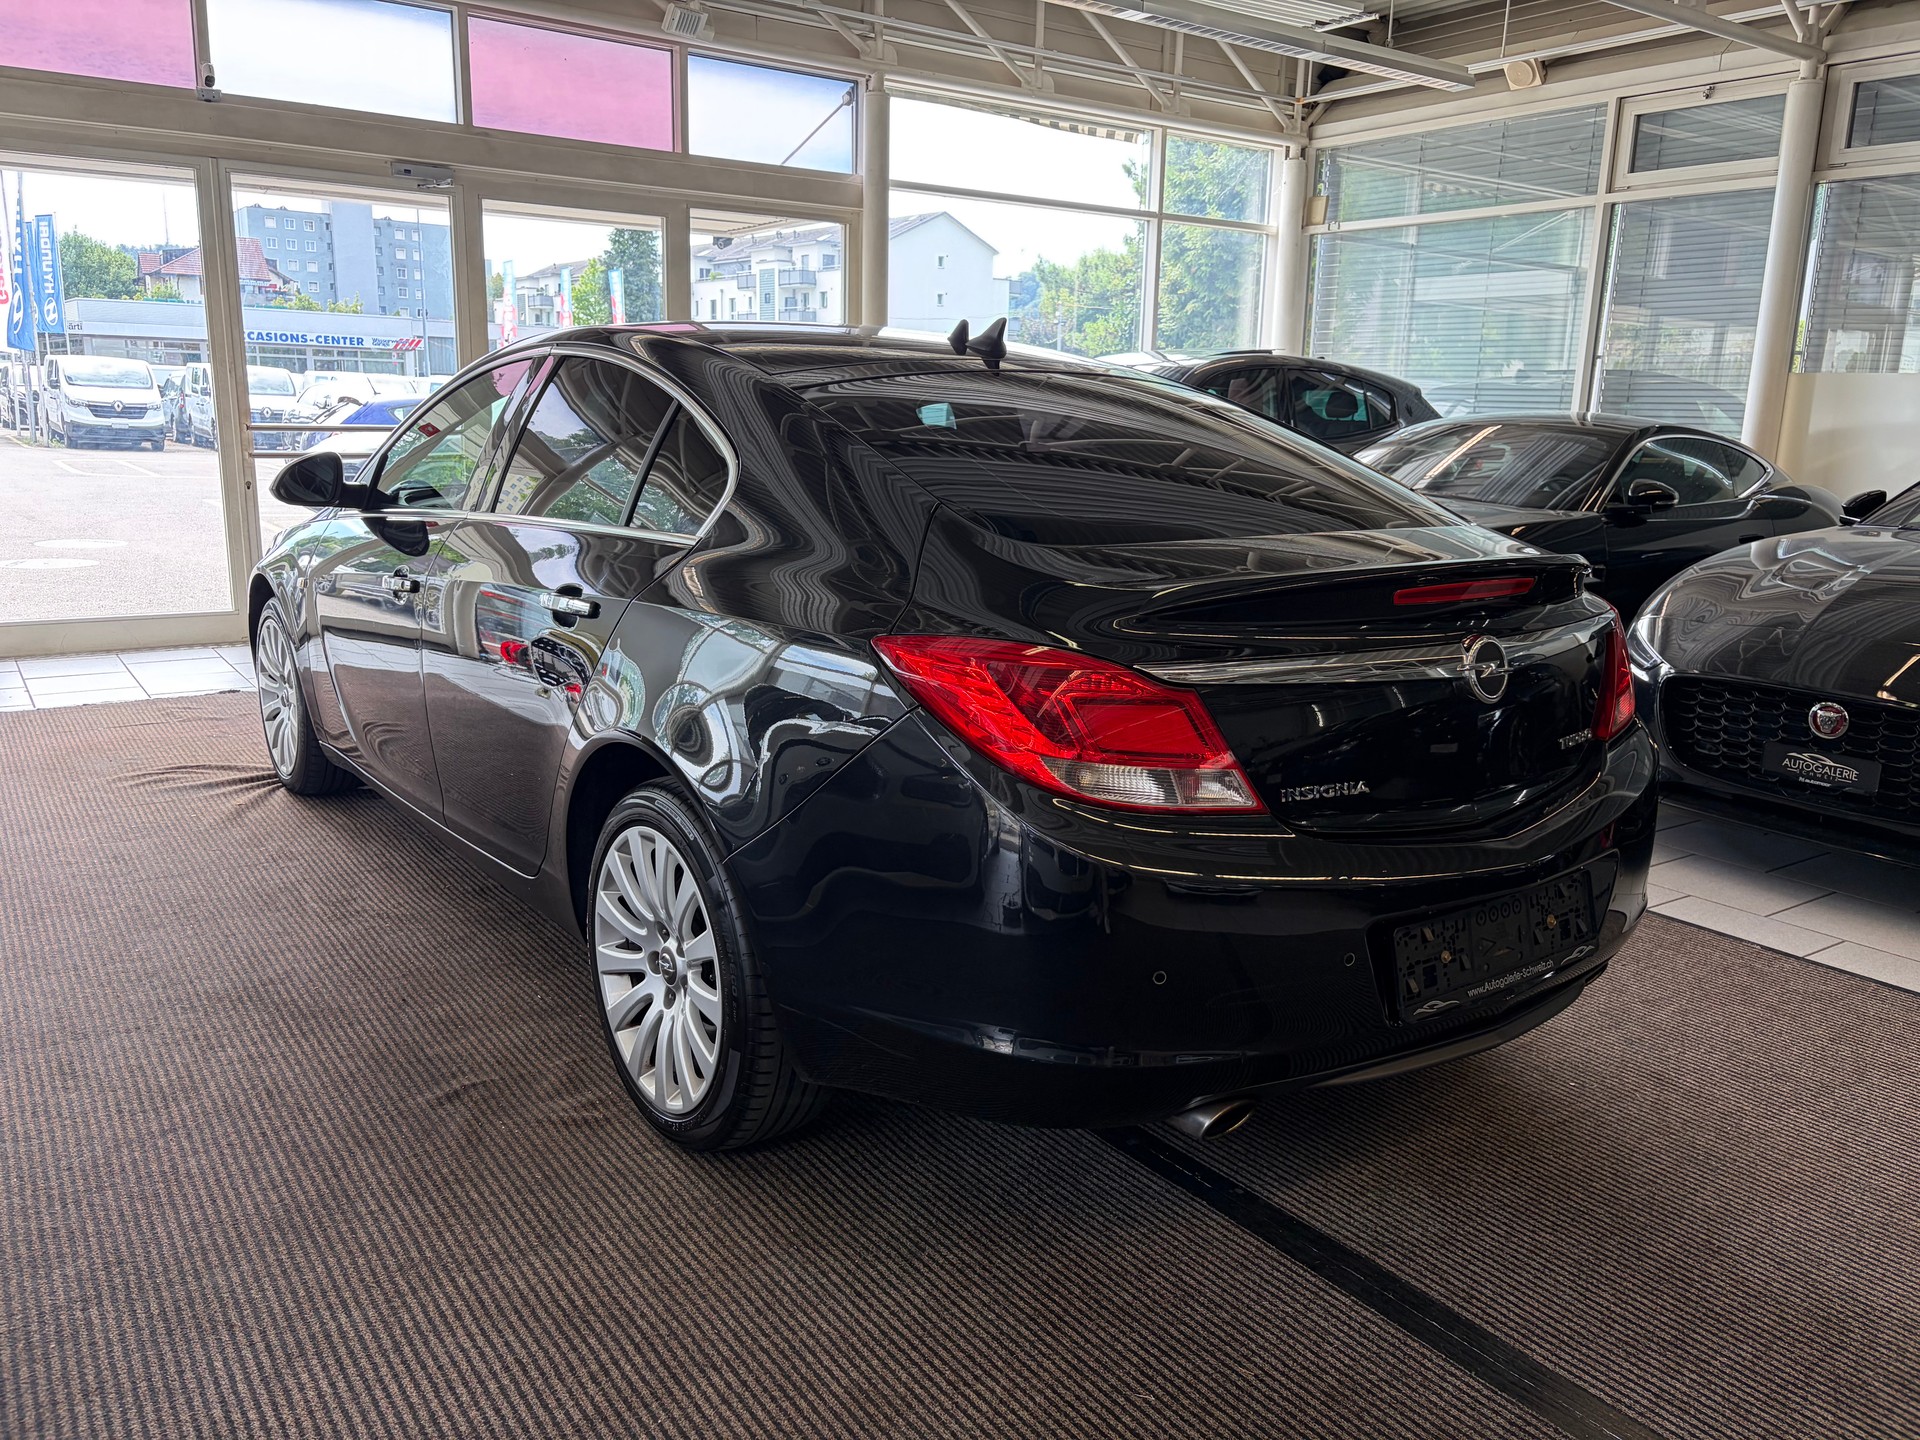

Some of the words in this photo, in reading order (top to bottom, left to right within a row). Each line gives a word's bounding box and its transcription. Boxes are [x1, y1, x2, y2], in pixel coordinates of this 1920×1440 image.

[67, 322, 83, 330] ärti
[245, 331, 365, 346] CASIONS-CENTER
[1782, 758, 1859, 781] AUTOGALERIE
[1281, 781, 1370, 803] INSIGNIA
[1467, 960, 1554, 997] www.Autogalerie-Schweiz.ch
